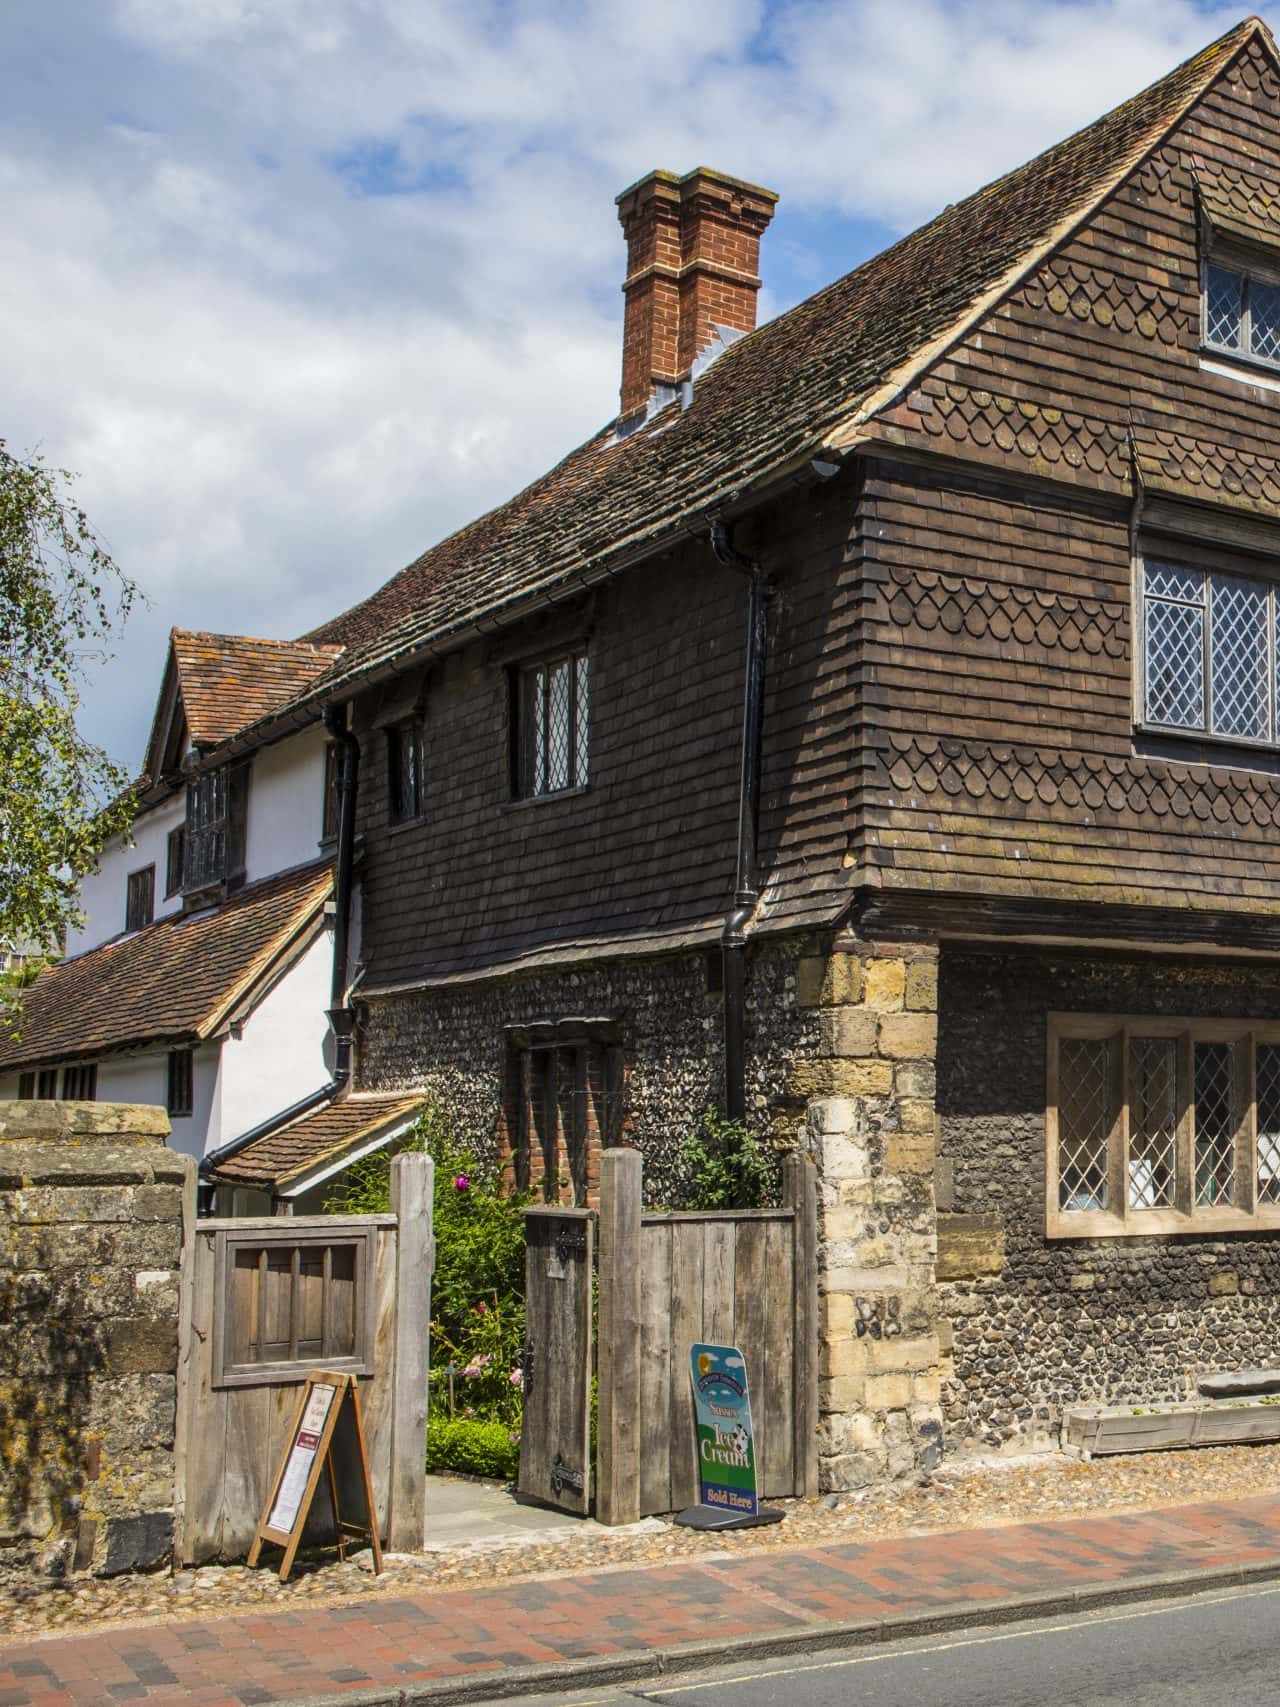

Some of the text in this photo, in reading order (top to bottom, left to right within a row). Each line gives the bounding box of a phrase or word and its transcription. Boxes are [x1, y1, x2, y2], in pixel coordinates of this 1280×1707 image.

[713, 1423, 735, 1447] Ice
[701, 1439, 750, 1468] Cream
[707, 1488, 753, 1509] Sold Here
